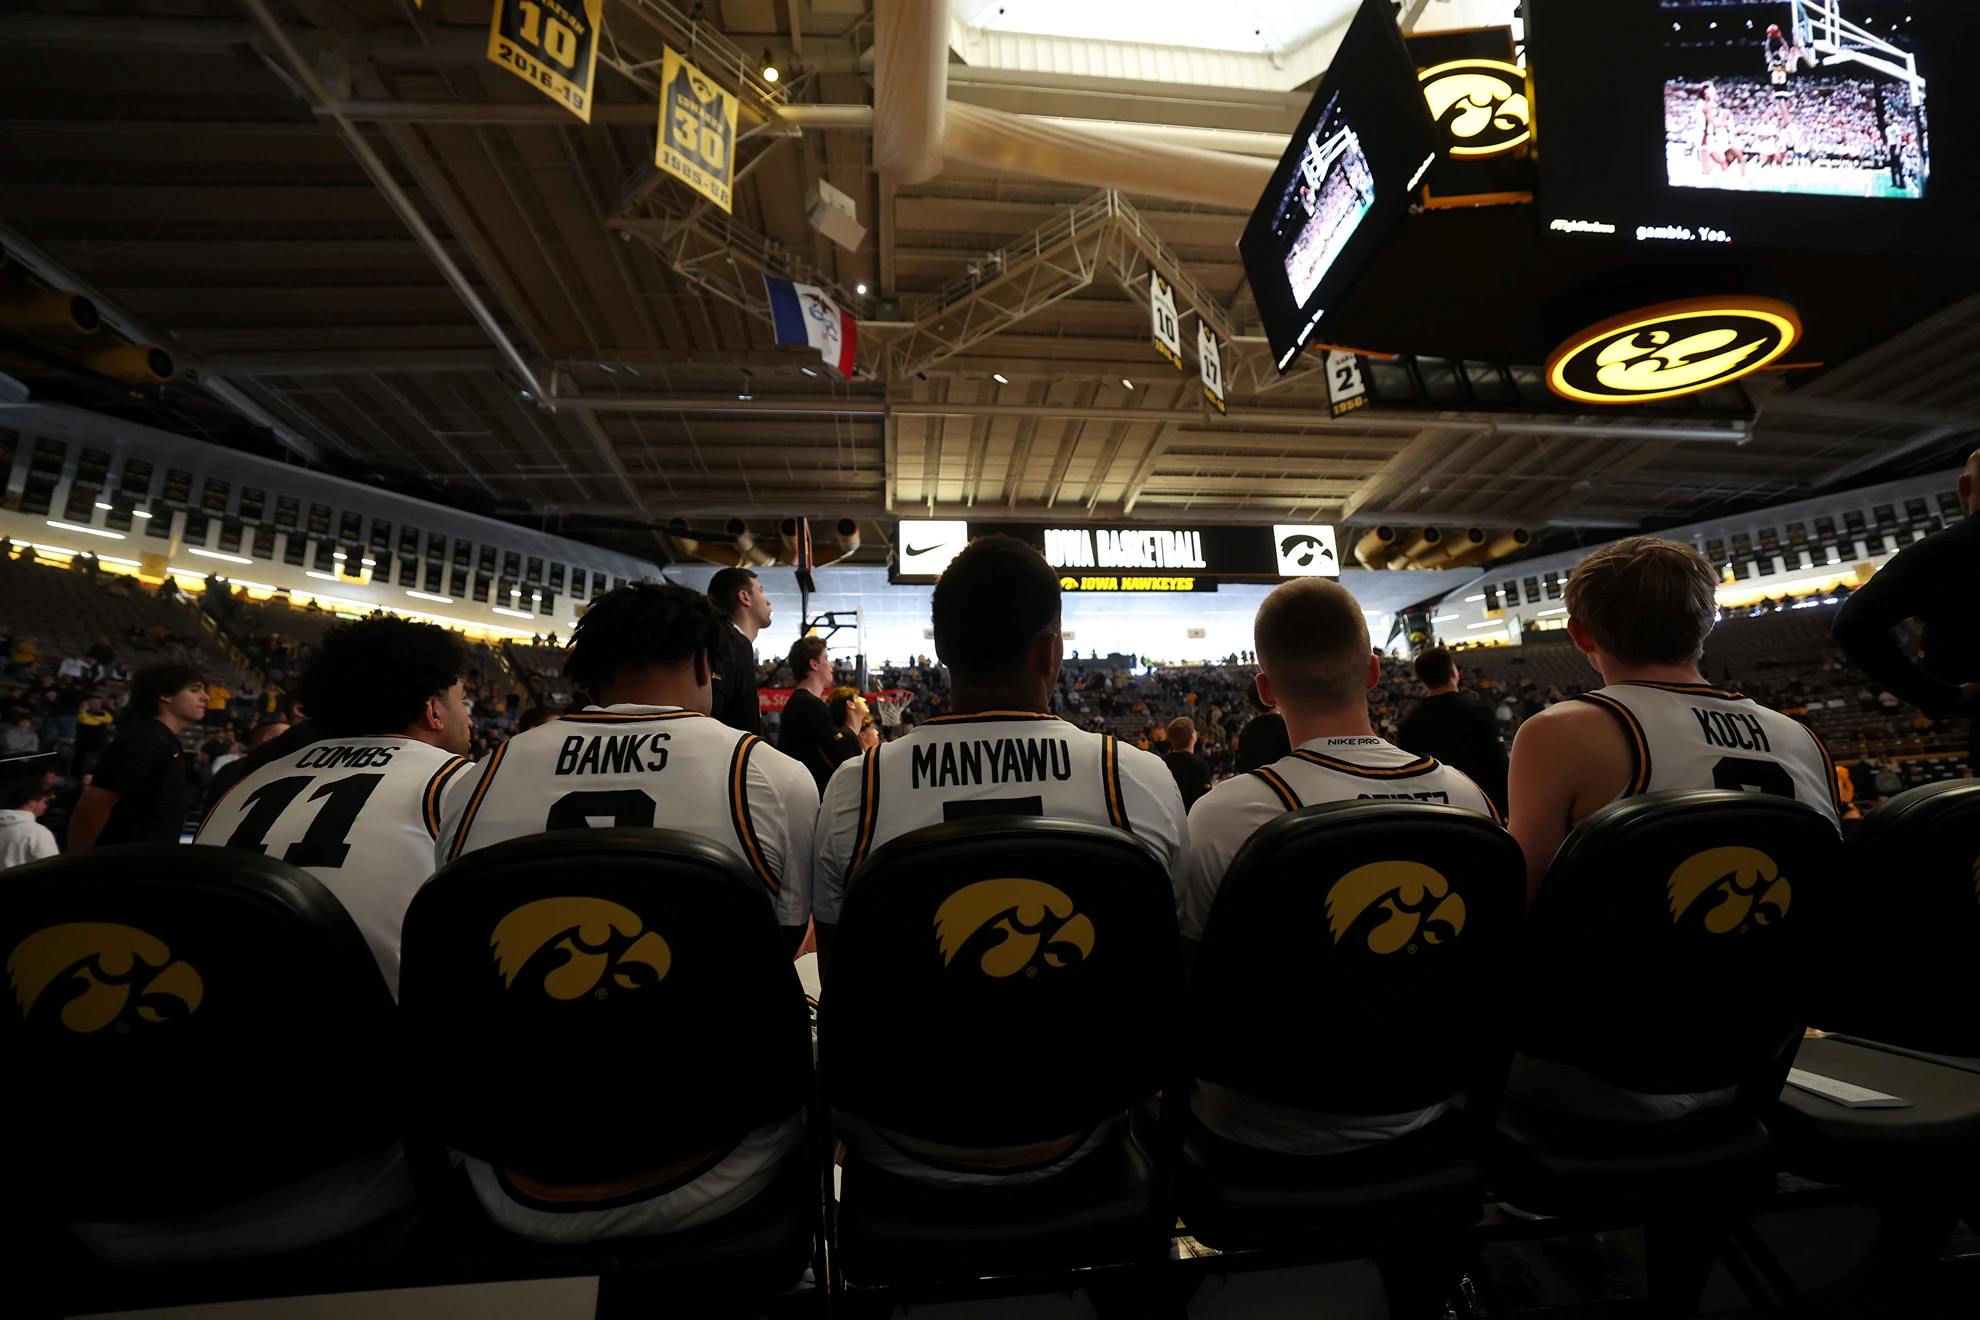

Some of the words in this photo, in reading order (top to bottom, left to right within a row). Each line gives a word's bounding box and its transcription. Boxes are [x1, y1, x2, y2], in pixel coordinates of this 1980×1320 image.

[519, 0, 577, 69] 10
[673, 105, 724, 169] 30
[1157, 307, 1176, 343] 10
[1204, 354, 1218, 385] 17
[1044, 529, 1095, 568] IOWA
[1096, 530, 1206, 568] BASKETBALL
[1080, 577, 1118, 590] IOWA
[1121, 577, 1194, 590] HAWKEYES
[1327, 738, 1357, 746] NIKE
[1358, 738, 1381, 746] PRO
[1691, 707, 1771, 752] KOCH
[295, 746, 400, 769] COMBS
[555, 733, 671, 775] BANKS
[912, 738, 1072, 789] MANYAWU
[226, 773, 386, 869] 11
